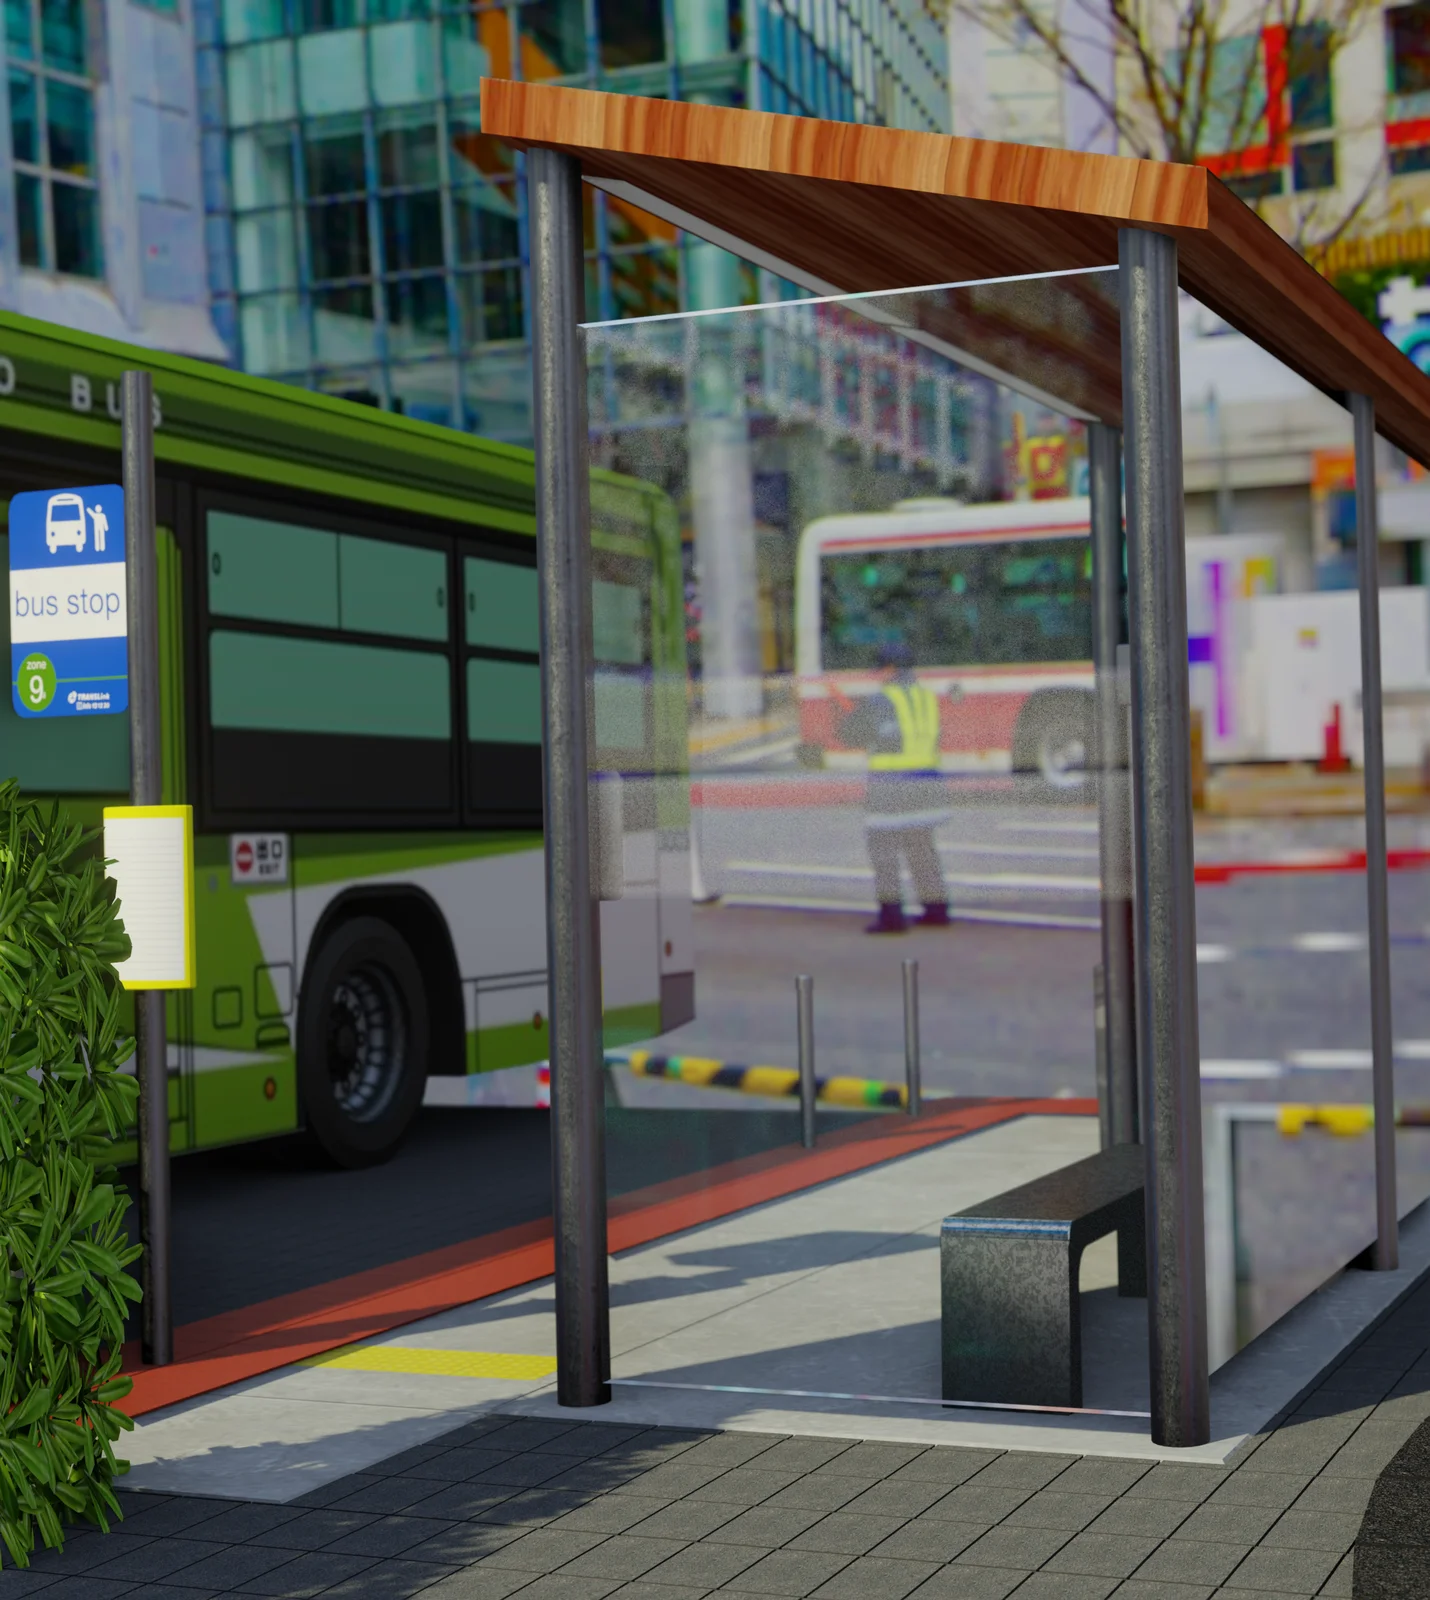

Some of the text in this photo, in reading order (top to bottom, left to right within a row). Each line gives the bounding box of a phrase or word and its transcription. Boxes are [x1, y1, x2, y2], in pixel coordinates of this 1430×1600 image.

[15, 588, 121, 621] bus stop
[26, 660, 47, 670] zone
[29, 675, 44, 704] 9
